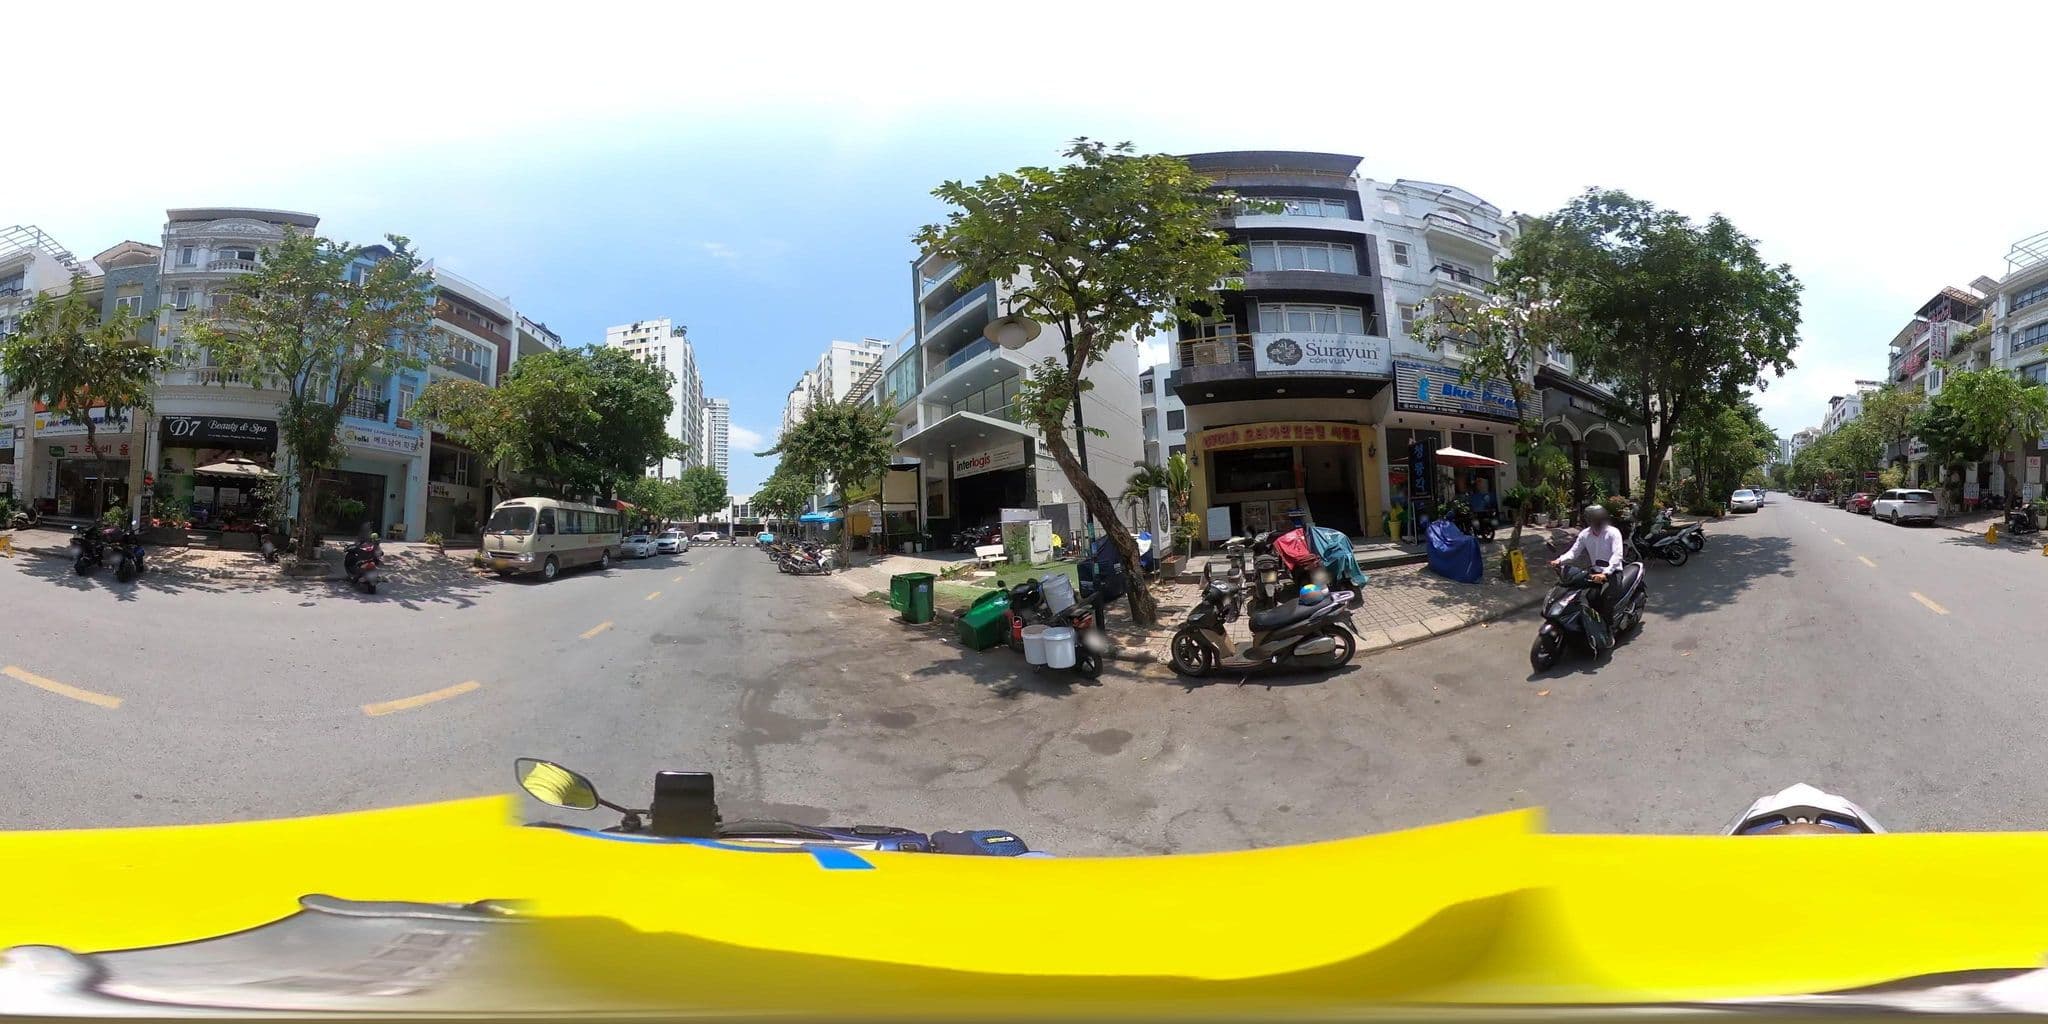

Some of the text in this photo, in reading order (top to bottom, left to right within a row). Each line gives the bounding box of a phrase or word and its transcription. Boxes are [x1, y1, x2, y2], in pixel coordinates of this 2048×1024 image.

[1305, 342, 1378, 361] Surayun
[1441, 382, 1476, 400] Blue
[169, 419, 268, 436] D7 Beauty & Spa
[955, 452, 991, 472] interlogis
